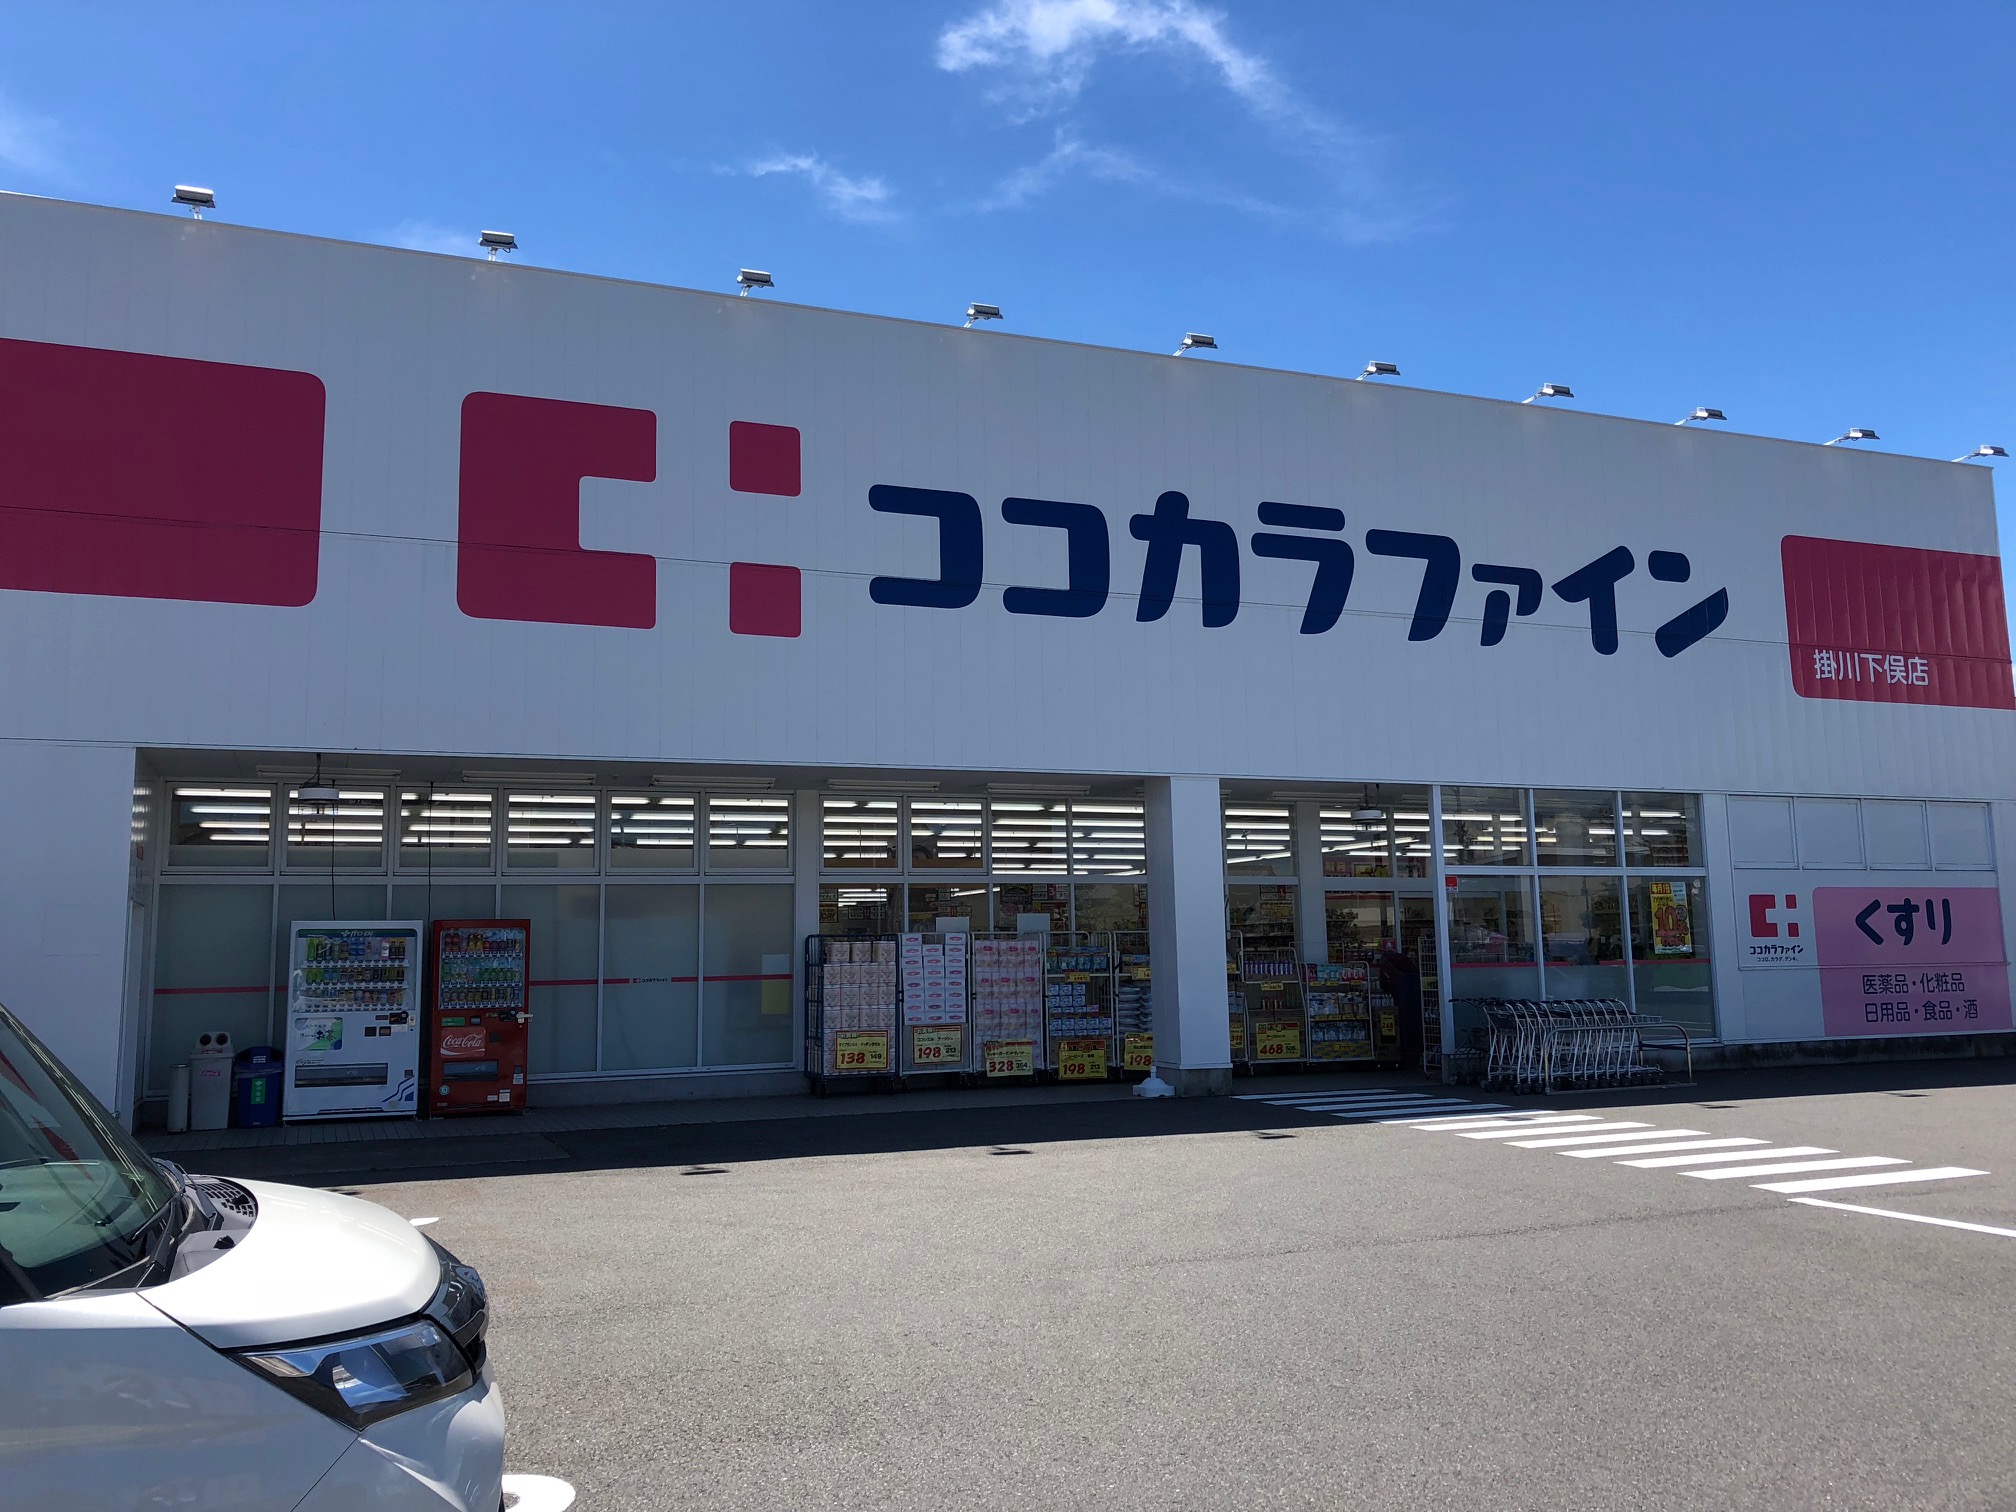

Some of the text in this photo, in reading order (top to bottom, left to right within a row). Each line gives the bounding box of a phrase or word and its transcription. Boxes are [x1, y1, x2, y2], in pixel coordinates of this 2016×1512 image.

[868, 484, 1729, 658] ココカラファイン
[1812, 648, 1930, 688] 掛川下俣店
[1854, 897, 1953, 946] くすり
[1749, 944, 1804, 955] ココカラファイン
[1862, 972, 1965, 995] 医薬品・化粧品
[1865, 999, 1979, 1023] 日用品・食品・酒
[918, 1046, 942, 1059] 198
[1260, 1043, 1284, 1055] 468
[840, 1052, 866, 1065] 138
[1129, 1055, 1152, 1066] 198
[988, 1060, 1014, 1073] 328
[1062, 1063, 1086, 1075] 198
